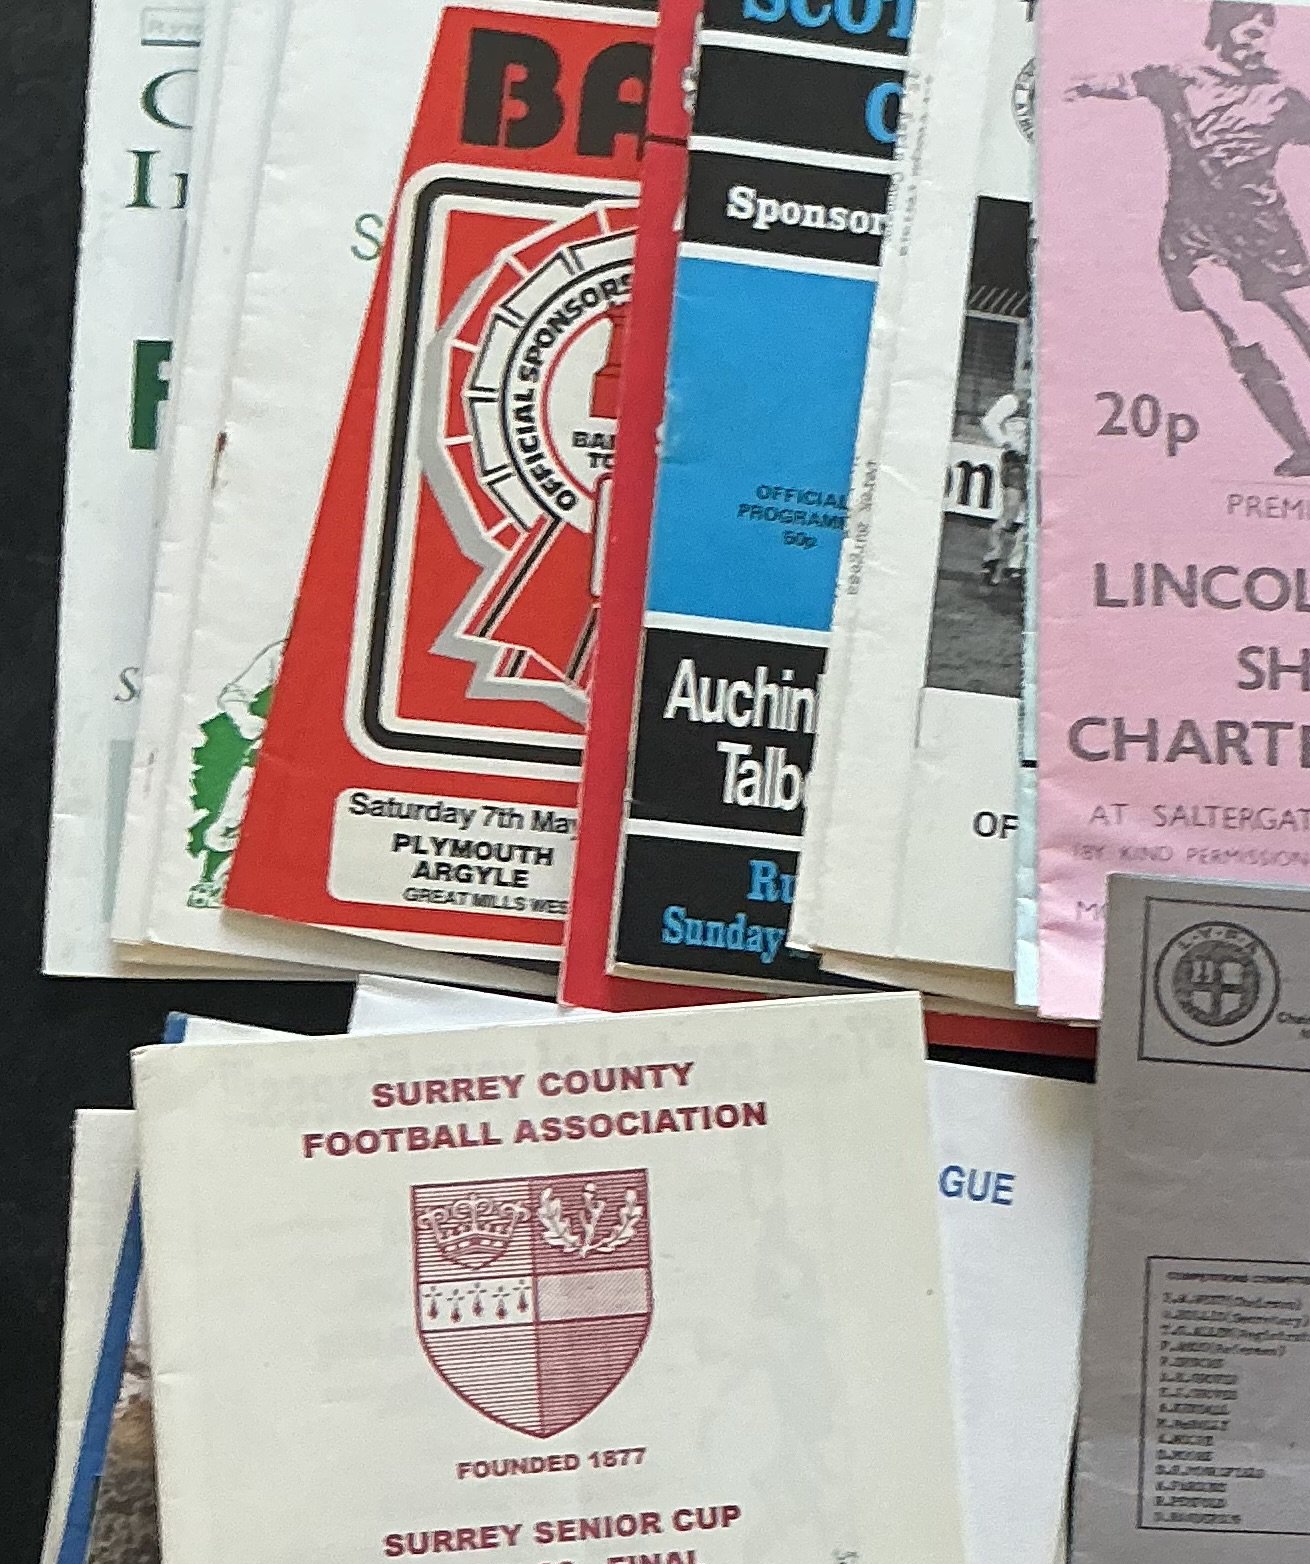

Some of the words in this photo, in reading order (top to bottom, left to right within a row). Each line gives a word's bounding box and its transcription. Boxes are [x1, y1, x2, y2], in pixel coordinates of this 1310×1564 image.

[1095, 391, 1200, 458] 20p
[513, 387, 579, 512] OFFICIAL
[348, 791, 478, 831] Saturday
[481, 804, 525, 830] 7th
[1089, 802, 1131, 826] AT
[391, 832, 555, 867] PLYMOUTH
[411, 860, 530, 889] ARGYLE
[402, 887, 467, 905] GREAT
[470, 893, 528, 912] MILLS
[661, 905, 788, 965] Sunday
[371, 1074, 526, 1108] SURREY
[537, 1060, 695, 1097] COUNTY
[302, 1121, 503, 1159] FOOTBALL
[513, 1101, 768, 1144] ASSOCIATION
[457, 1453, 581, 1481] FOUNDED
[587, 1447, 647, 1469] 1877
[382, 1523, 523, 1557] SURREY
[534, 1511, 665, 1544] SENIOR
[672, 1504, 742, 1532] CUP
